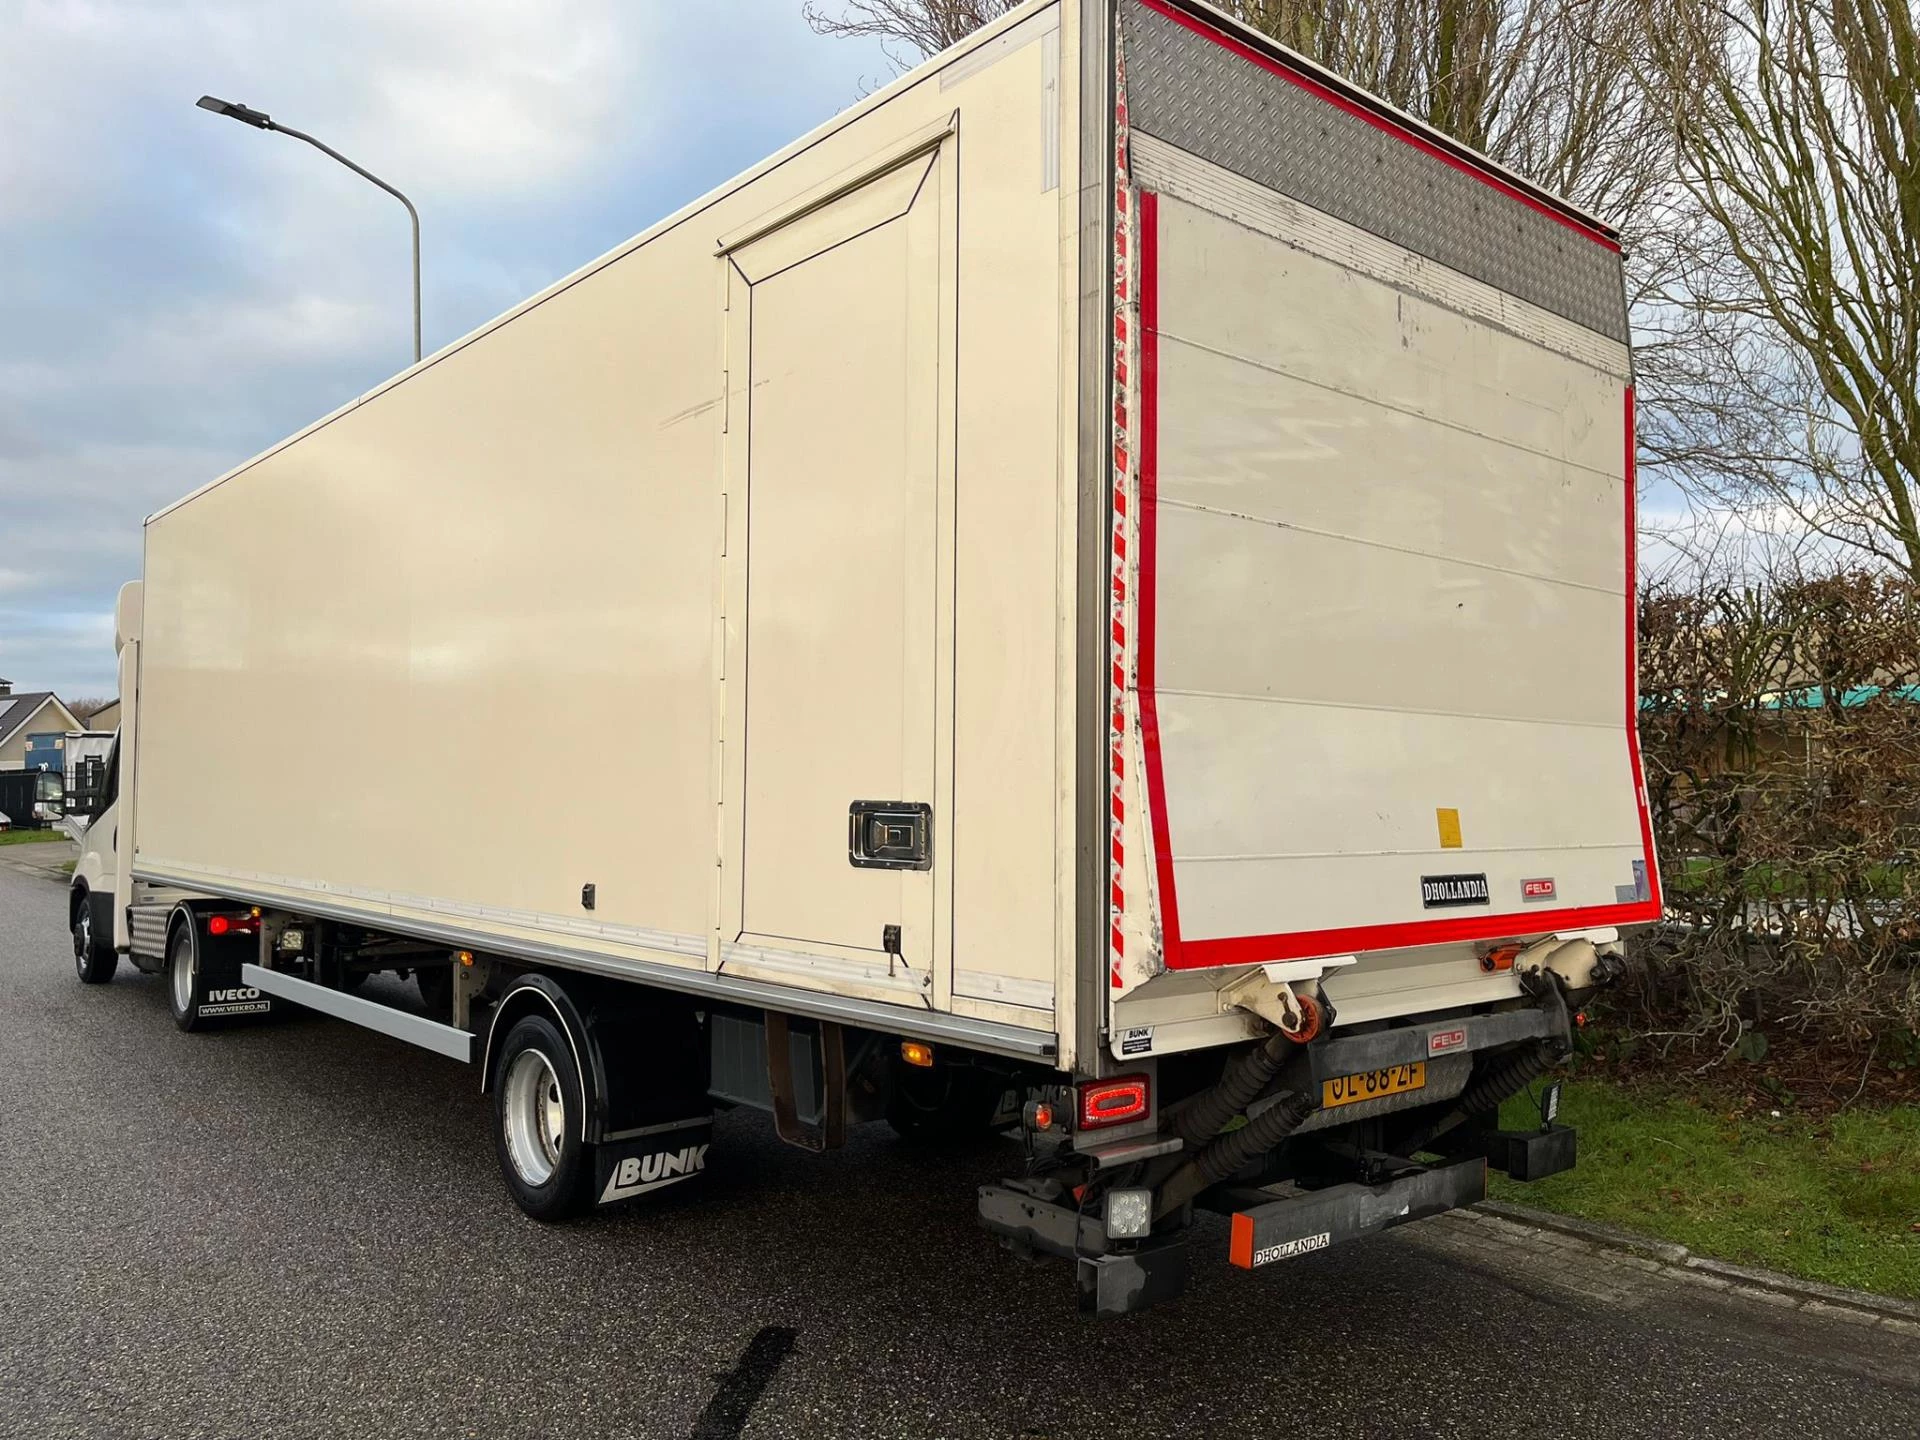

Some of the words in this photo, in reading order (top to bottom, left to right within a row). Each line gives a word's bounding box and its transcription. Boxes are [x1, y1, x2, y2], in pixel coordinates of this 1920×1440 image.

[1424, 879, 1488, 901] DHOLLANDIA
[1525, 882, 1553, 895] FELD
[208, 987, 261, 1002] IVECO
[1129, 1028, 1149, 1039] BUNK
[1432, 1032, 1464, 1048] FELD
[617, 1143, 710, 1187] BUNK
[1255, 1235, 1328, 1265] DHOLLANDIA
